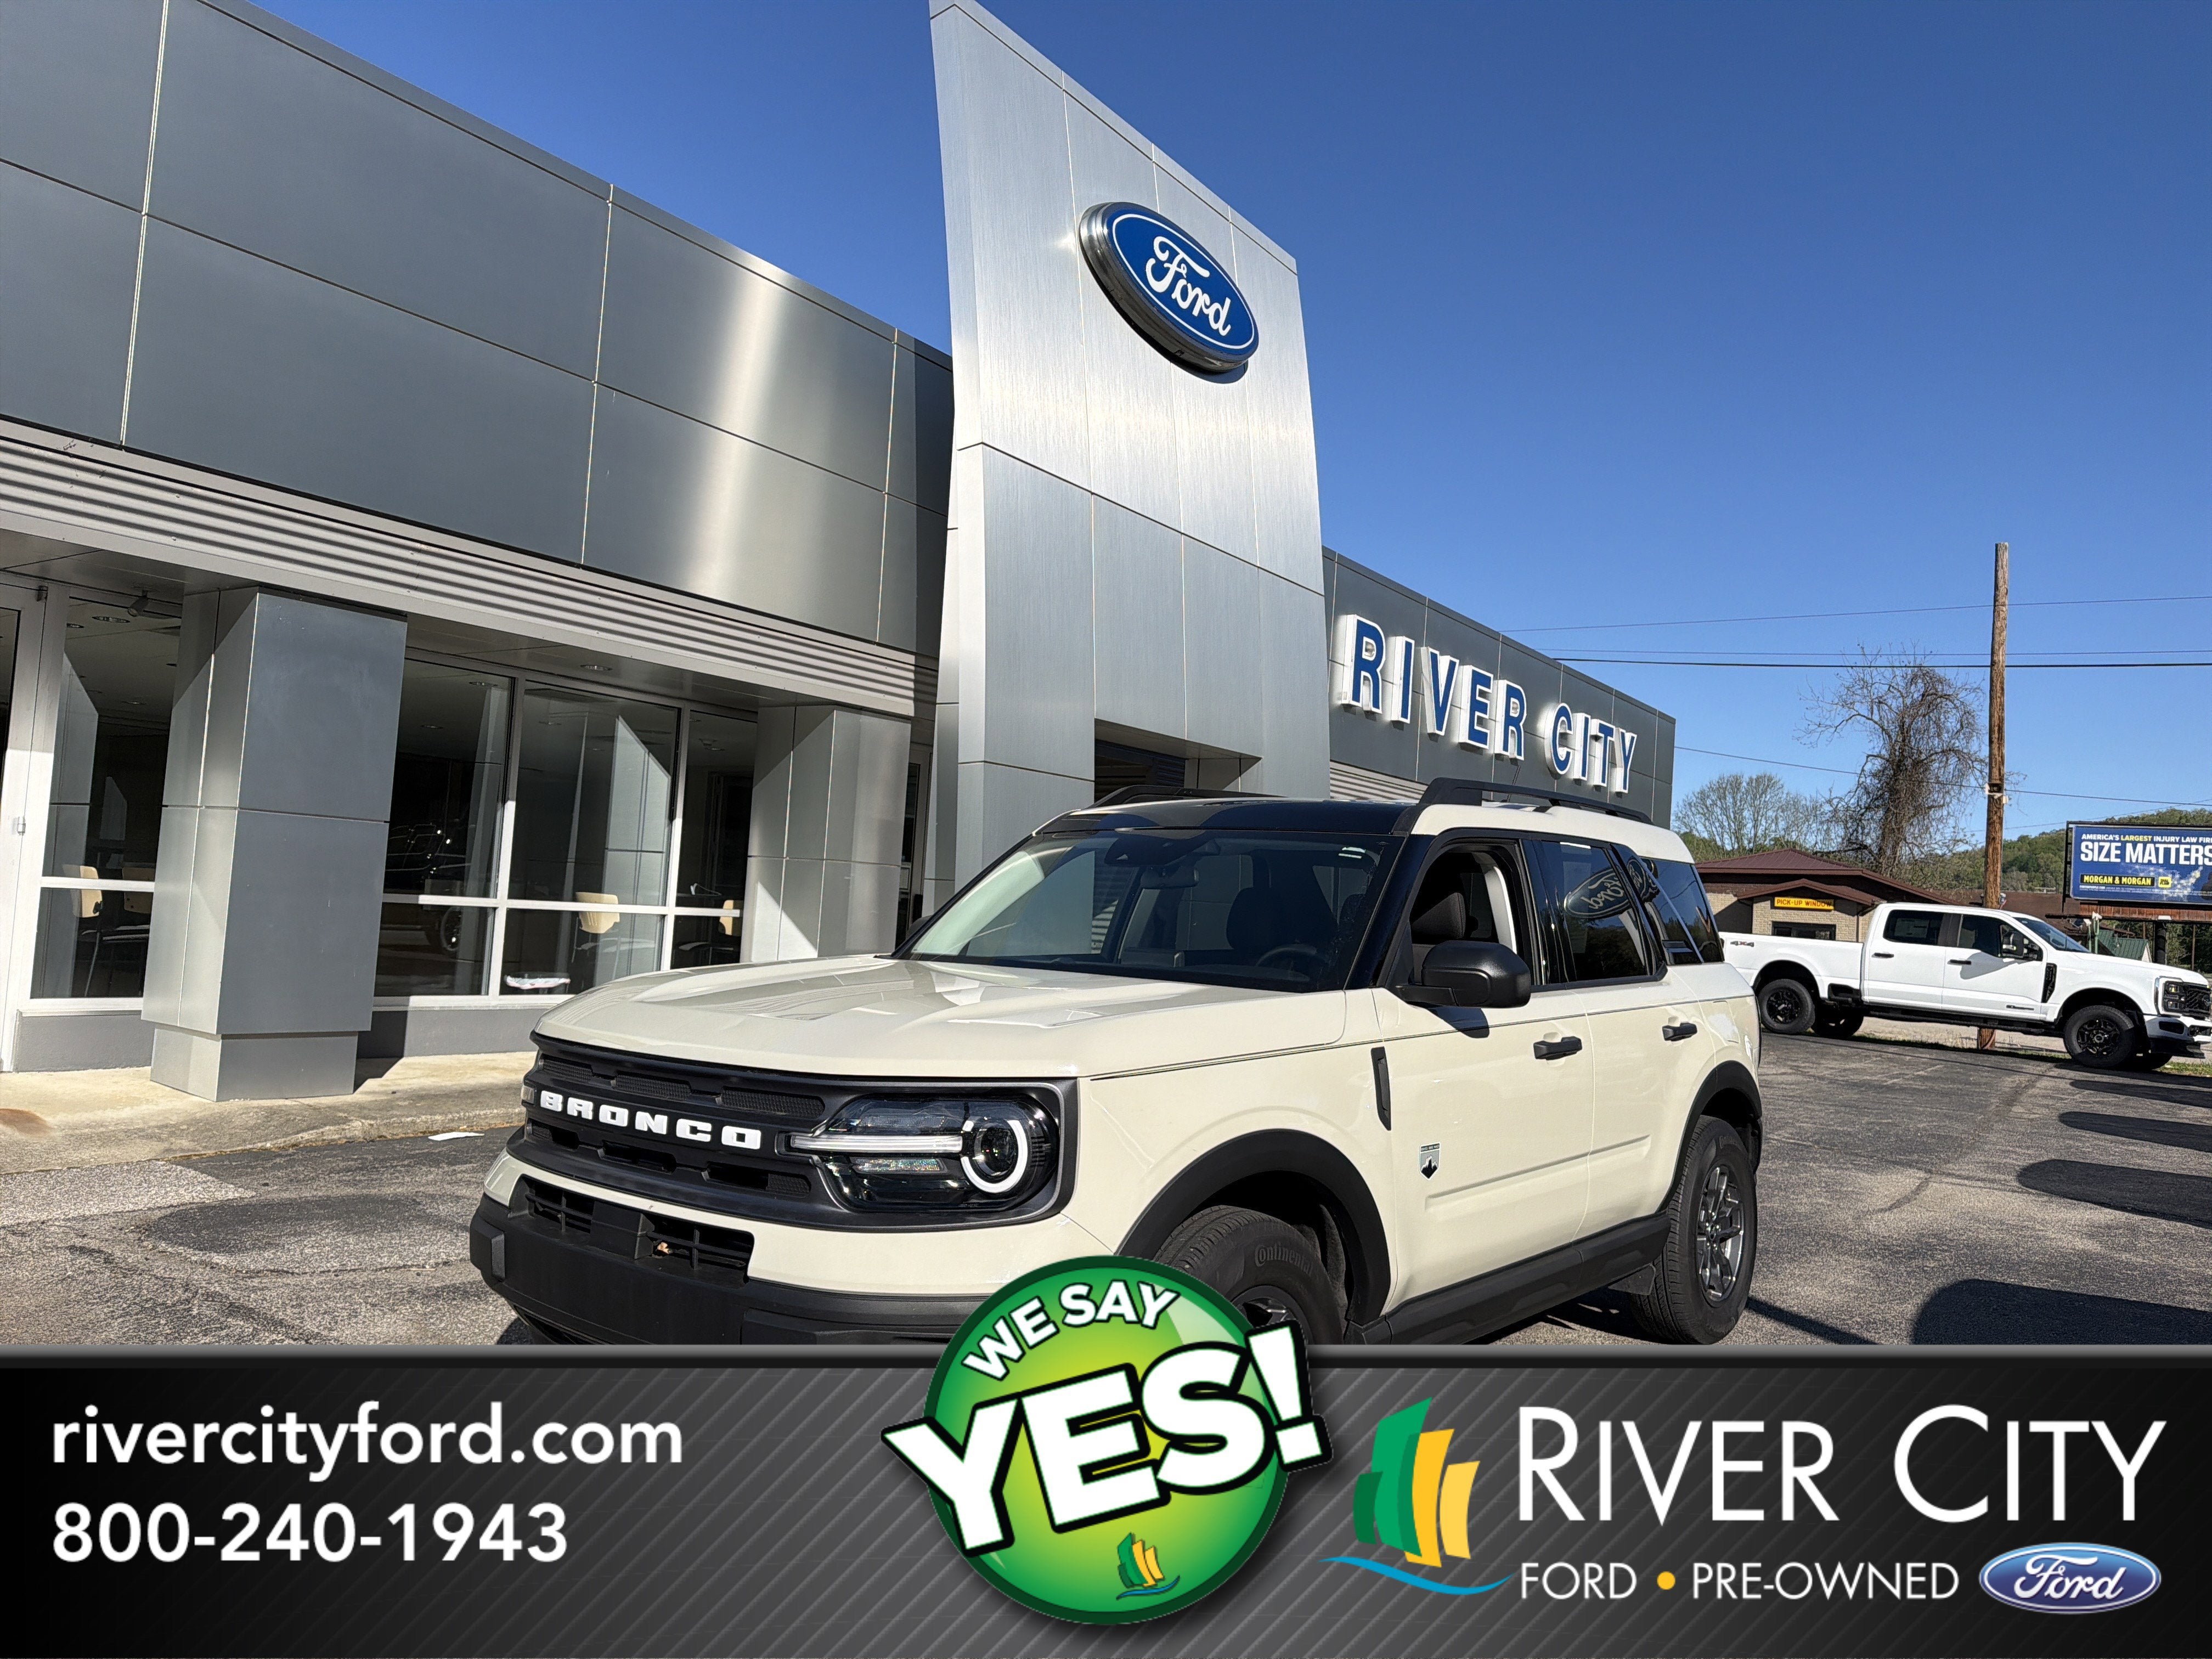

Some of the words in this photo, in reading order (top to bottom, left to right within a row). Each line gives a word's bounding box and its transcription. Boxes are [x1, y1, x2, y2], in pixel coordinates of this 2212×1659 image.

[1146, 236, 1232, 336] Ford
[1341, 614, 1527, 761] RIVER
[1544, 702, 1638, 794] CITY
[2080, 841, 2121, 862] SIZE
[2125, 843, 2212, 866] MATTERS
[2084, 875, 2113, 884] MORGAN
[2114, 876, 2120, 884] &
[2121, 877, 2151, 885] MORGAN
[540, 1090, 761, 1150] BRONCO
[1255, 1242, 1313, 1277] Continental
